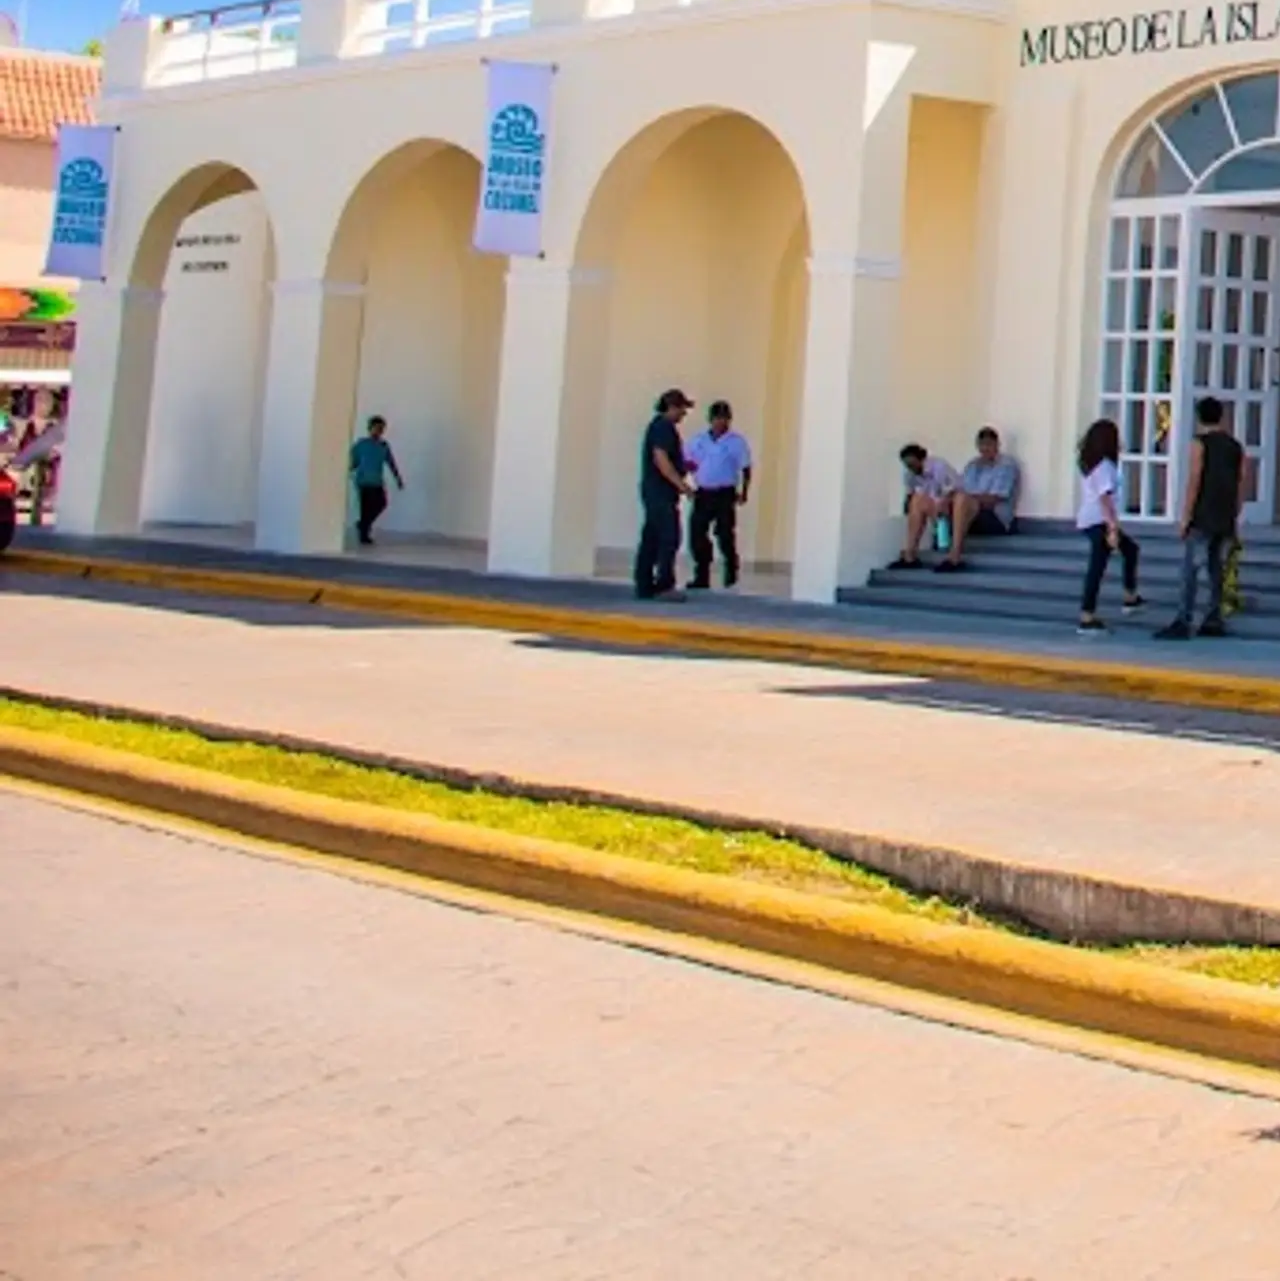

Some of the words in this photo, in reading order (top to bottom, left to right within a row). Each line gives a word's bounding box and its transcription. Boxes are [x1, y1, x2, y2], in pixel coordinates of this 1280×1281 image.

[1020, 16, 1127, 68] MUSEO
[1132, 10, 1173, 54] DE
[1177, 6, 1217, 49] LA
